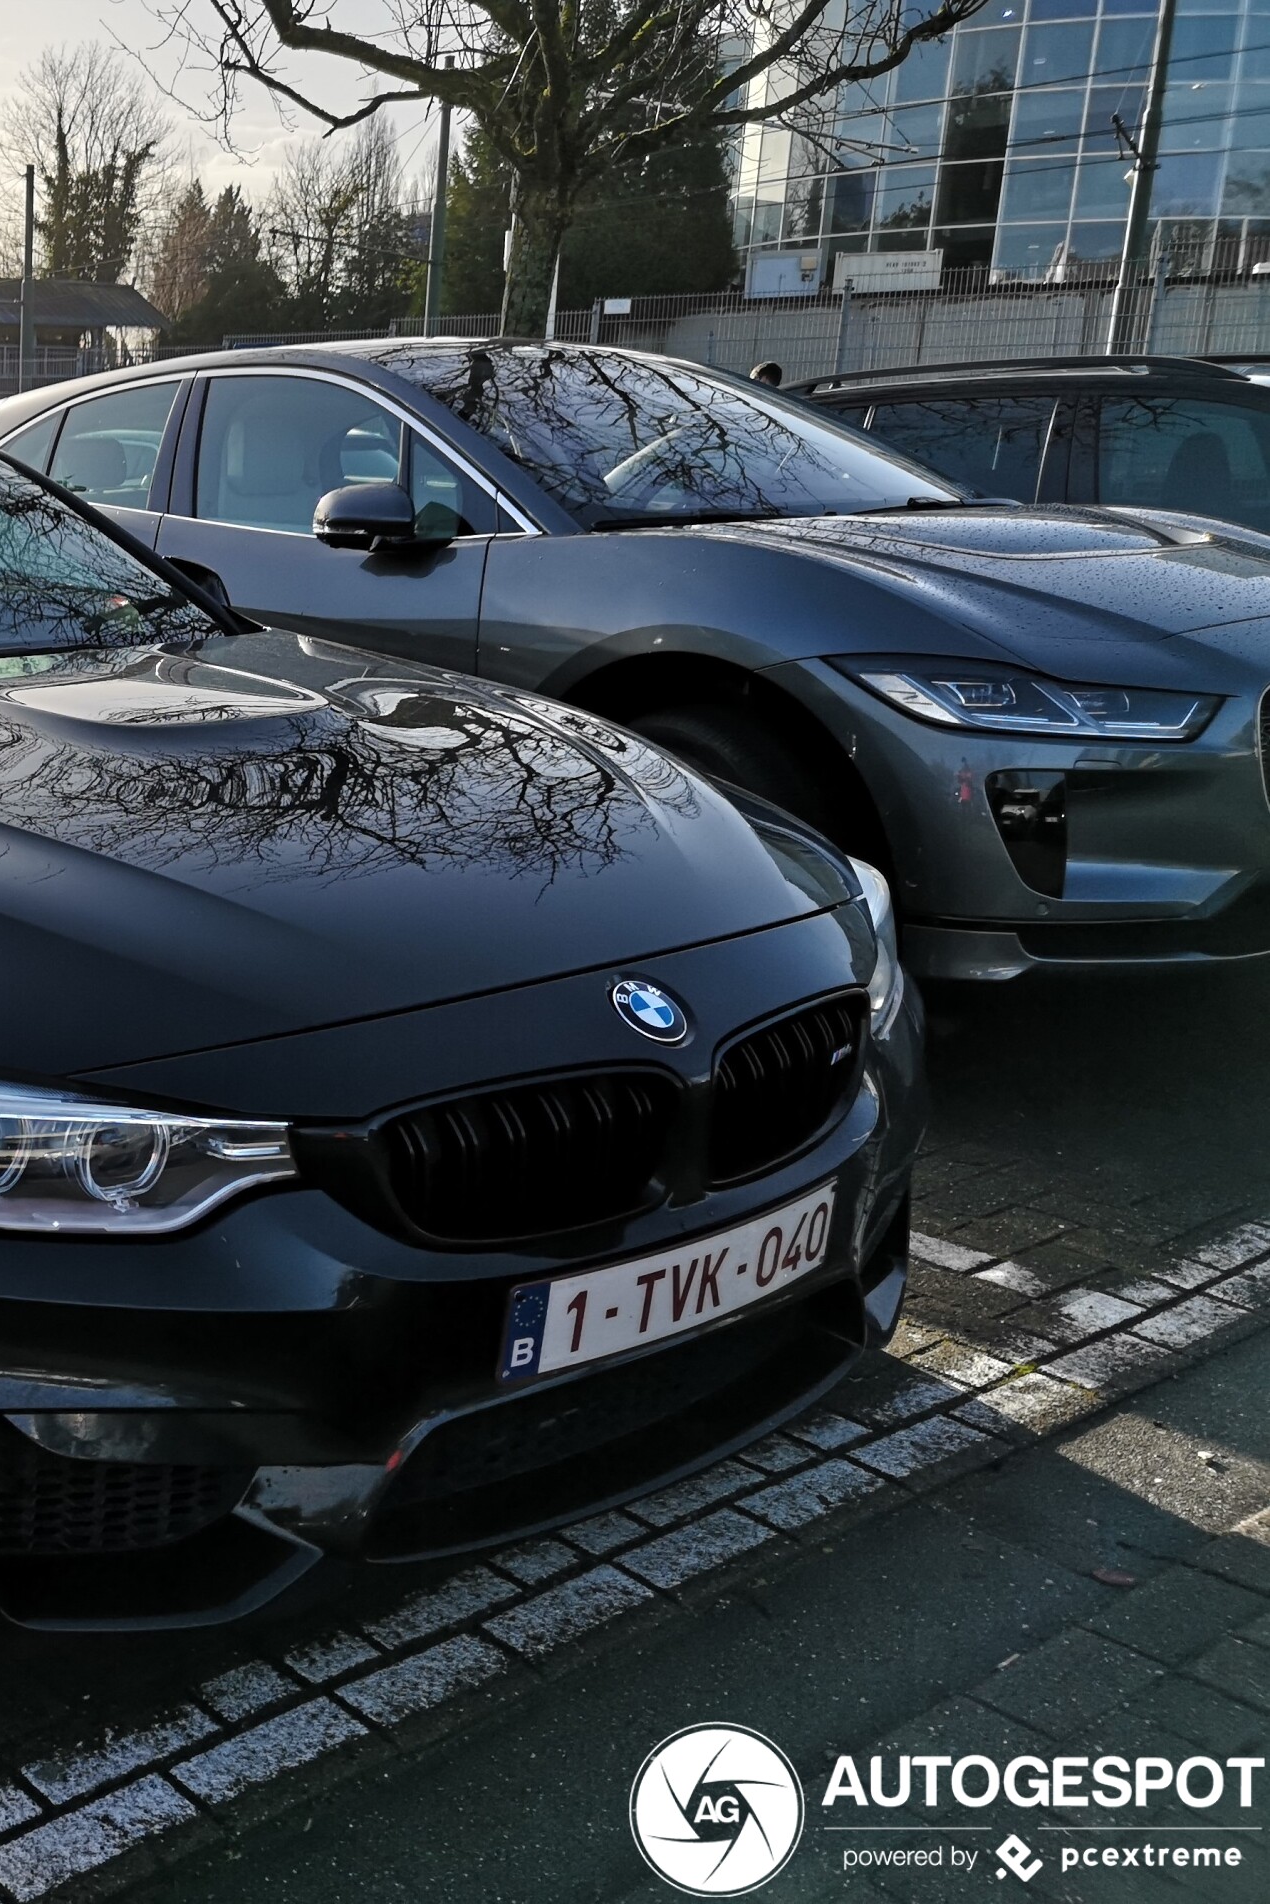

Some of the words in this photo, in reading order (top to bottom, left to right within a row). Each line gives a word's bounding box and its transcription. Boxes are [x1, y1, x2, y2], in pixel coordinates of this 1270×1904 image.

[616, 982, 662, 1005] BMW
[566, 1201, 829, 1354] 1-TVK-040
[510, 1336, 534, 1368] B
